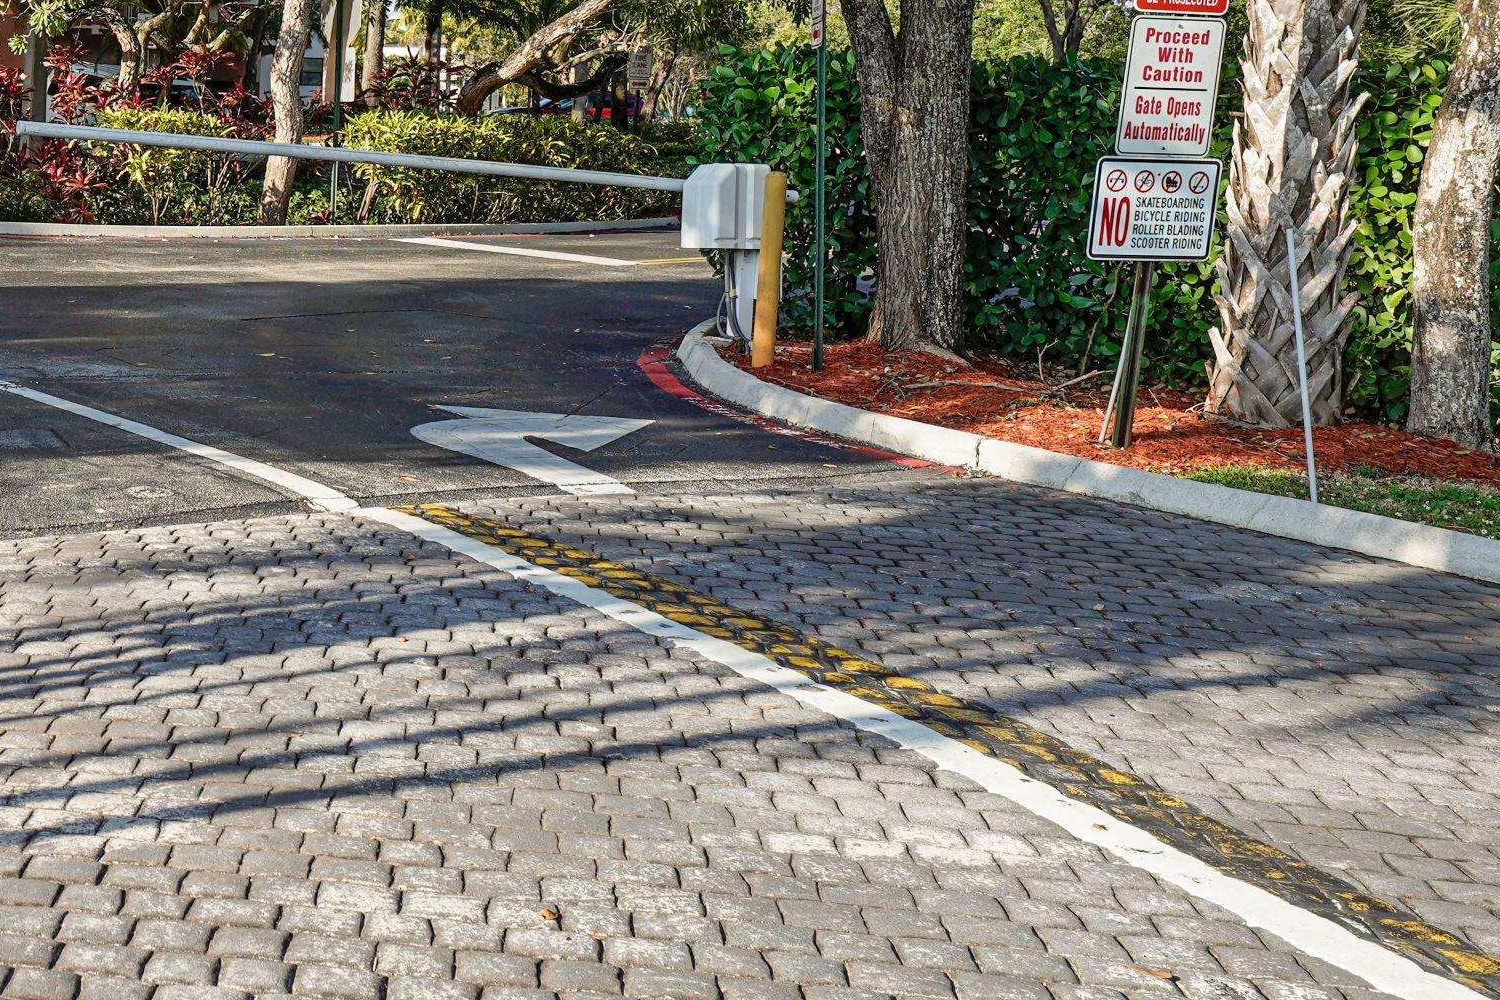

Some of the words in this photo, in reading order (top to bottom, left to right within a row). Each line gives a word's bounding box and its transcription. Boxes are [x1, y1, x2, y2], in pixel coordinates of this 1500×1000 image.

[1145, 27, 1211, 46] Proceed
[1158, 46, 1194, 64] With
[1142, 65, 1204, 83] Caution
[1135, 95, 1162, 115] Gate
[1166, 96, 1202, 118] Opens
[1124, 121, 1206, 145] Automatically
[1135, 196, 1205, 210] SKATEBOARDING
[1098, 196, 1131, 248] NO
[1134, 210, 1172, 222] BICYCLE
[1173, 211, 1206, 223] RIDING
[1132, 224, 1165, 236] ROLLER
[1166, 224, 1204, 236] BLADING
[1130, 237, 1169, 249] SCOOTER
[1171, 238, 1202, 250] RIDING
